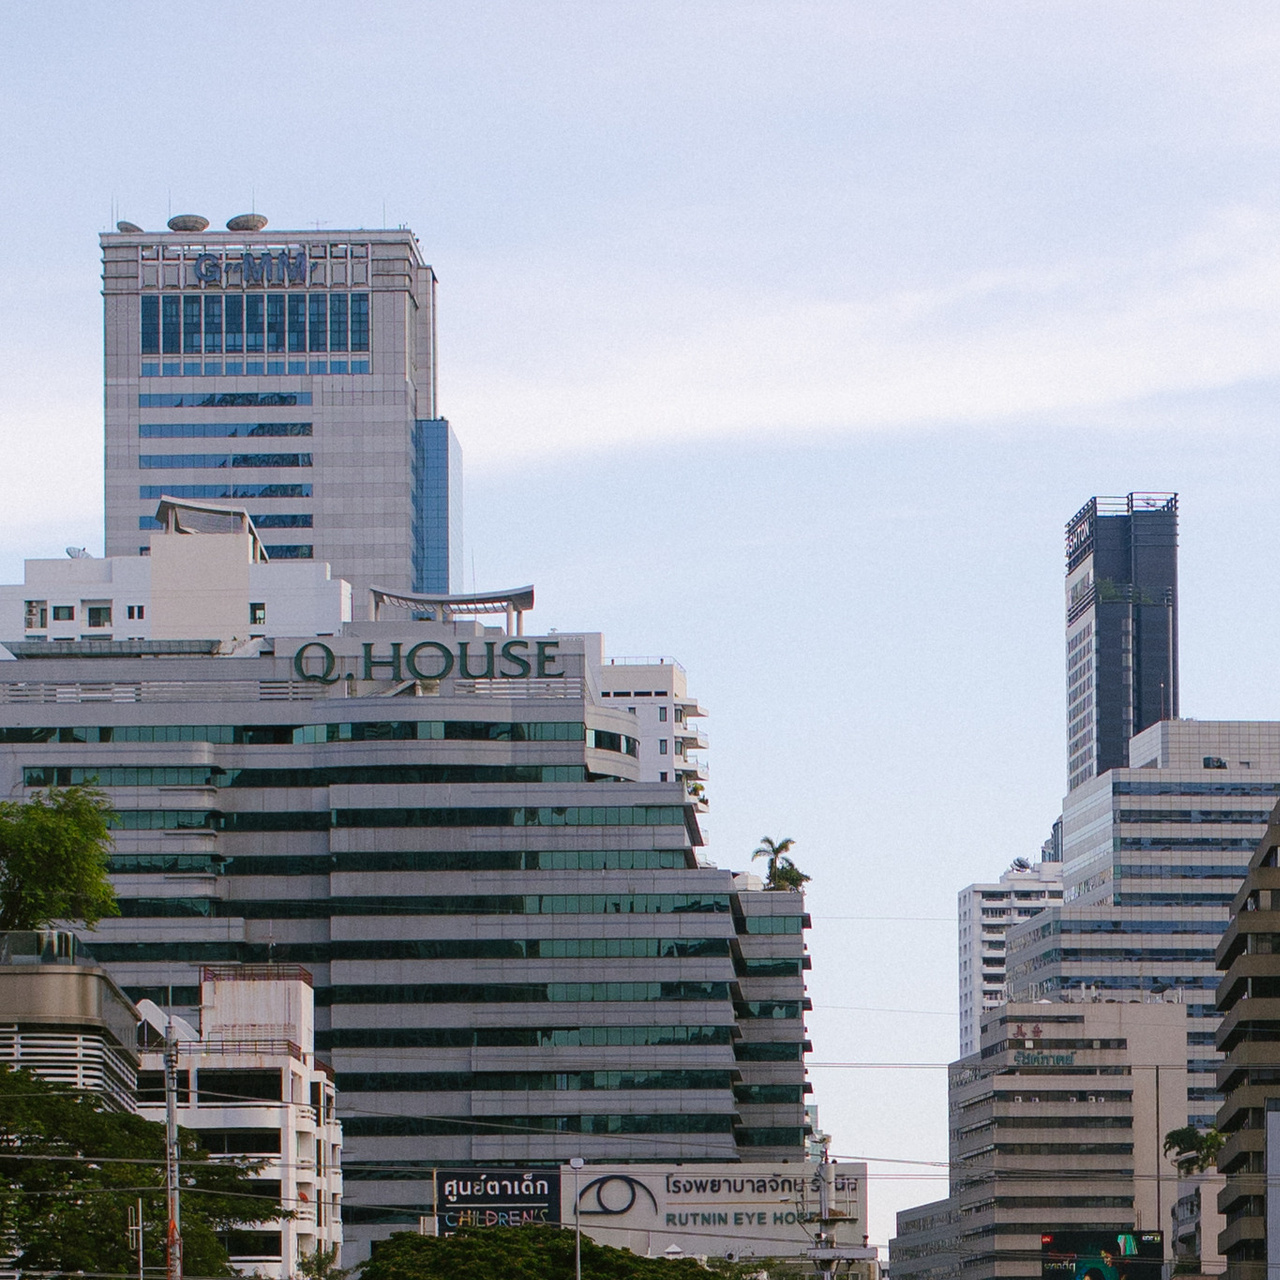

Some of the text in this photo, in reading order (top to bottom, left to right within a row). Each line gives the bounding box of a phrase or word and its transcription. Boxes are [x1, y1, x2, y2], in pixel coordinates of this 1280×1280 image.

[362, 640, 566, 681] HOUSE
[444, 1173, 549, 1202] ศูนย์ตาเด็ก
[445, 1208, 549, 1228] CHILDREN'S
[665, 1212, 729, 1226] RUTNIN
[733, 1212, 768, 1226] EYE
